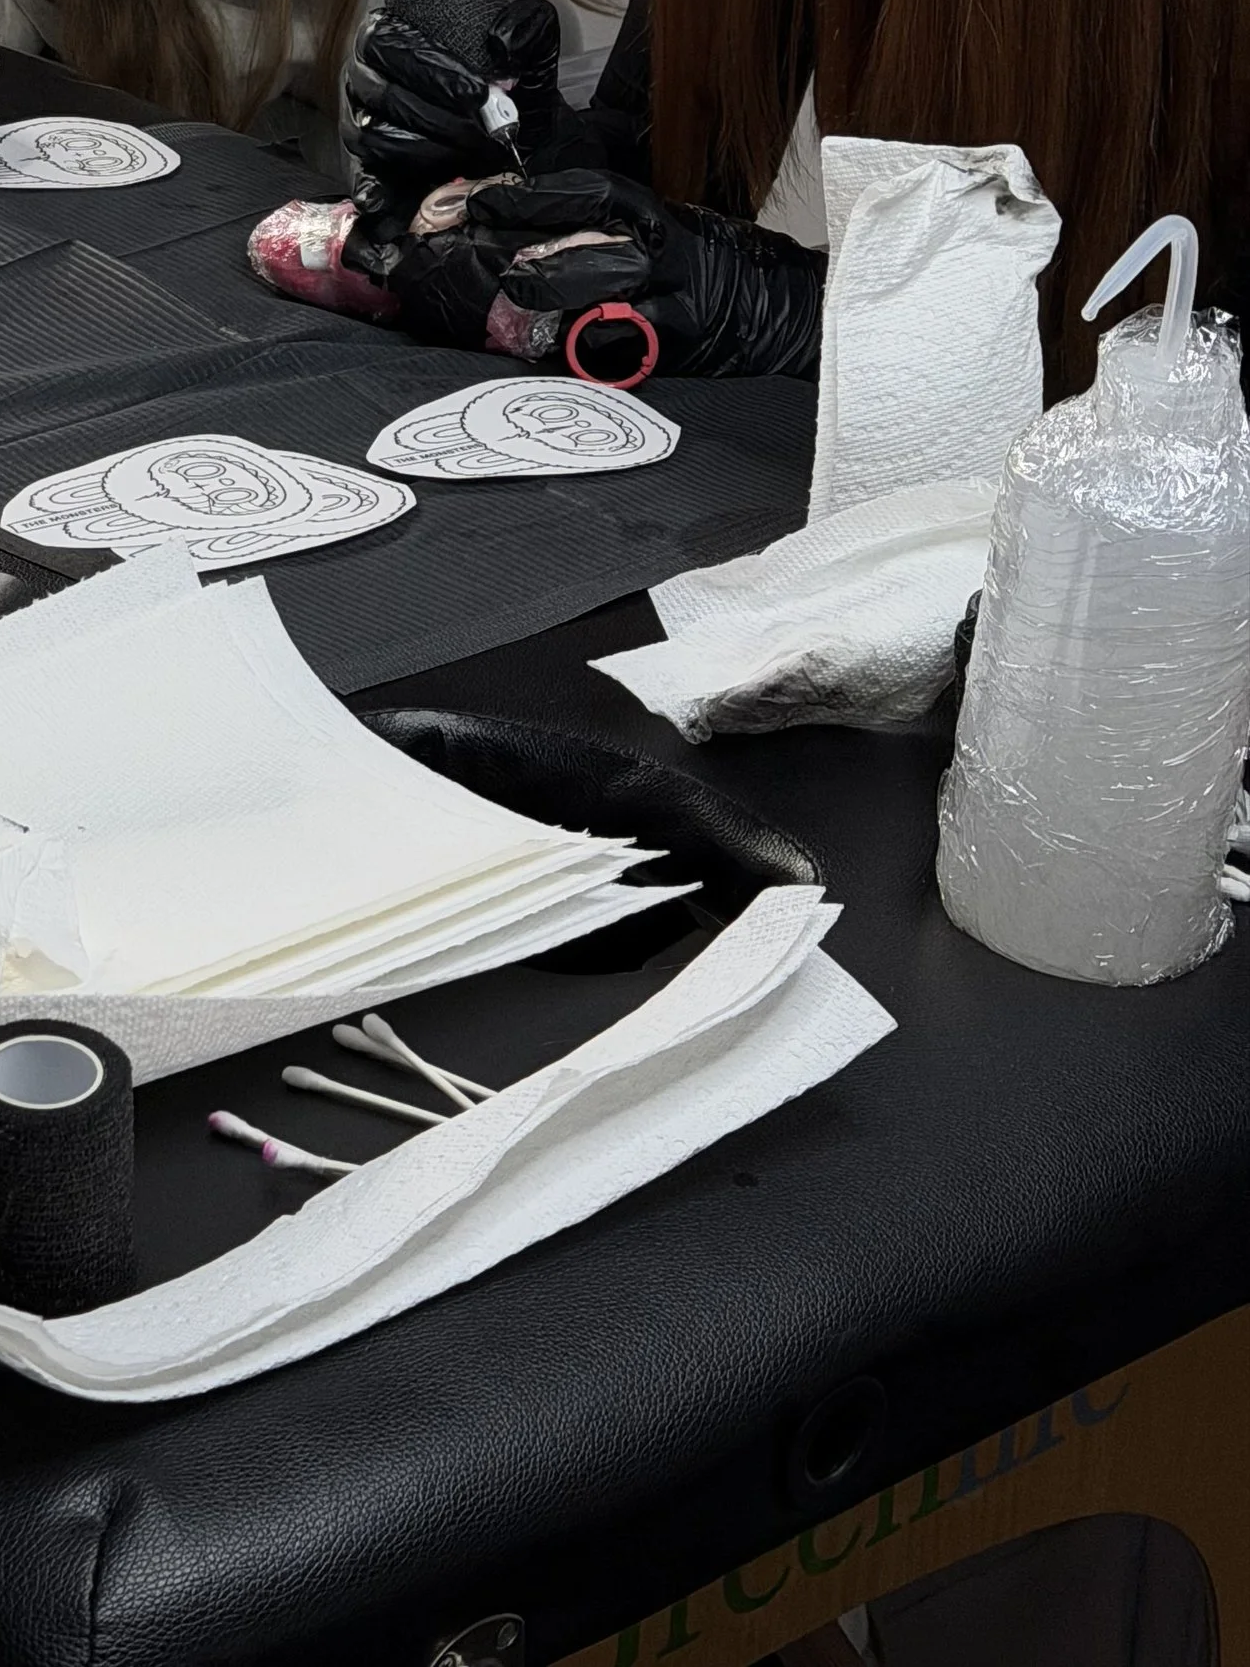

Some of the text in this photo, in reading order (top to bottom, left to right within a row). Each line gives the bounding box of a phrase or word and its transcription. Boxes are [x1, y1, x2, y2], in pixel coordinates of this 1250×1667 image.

[394, 455, 419, 464] THE
[21, 503, 119, 529] THE MONSTERS
